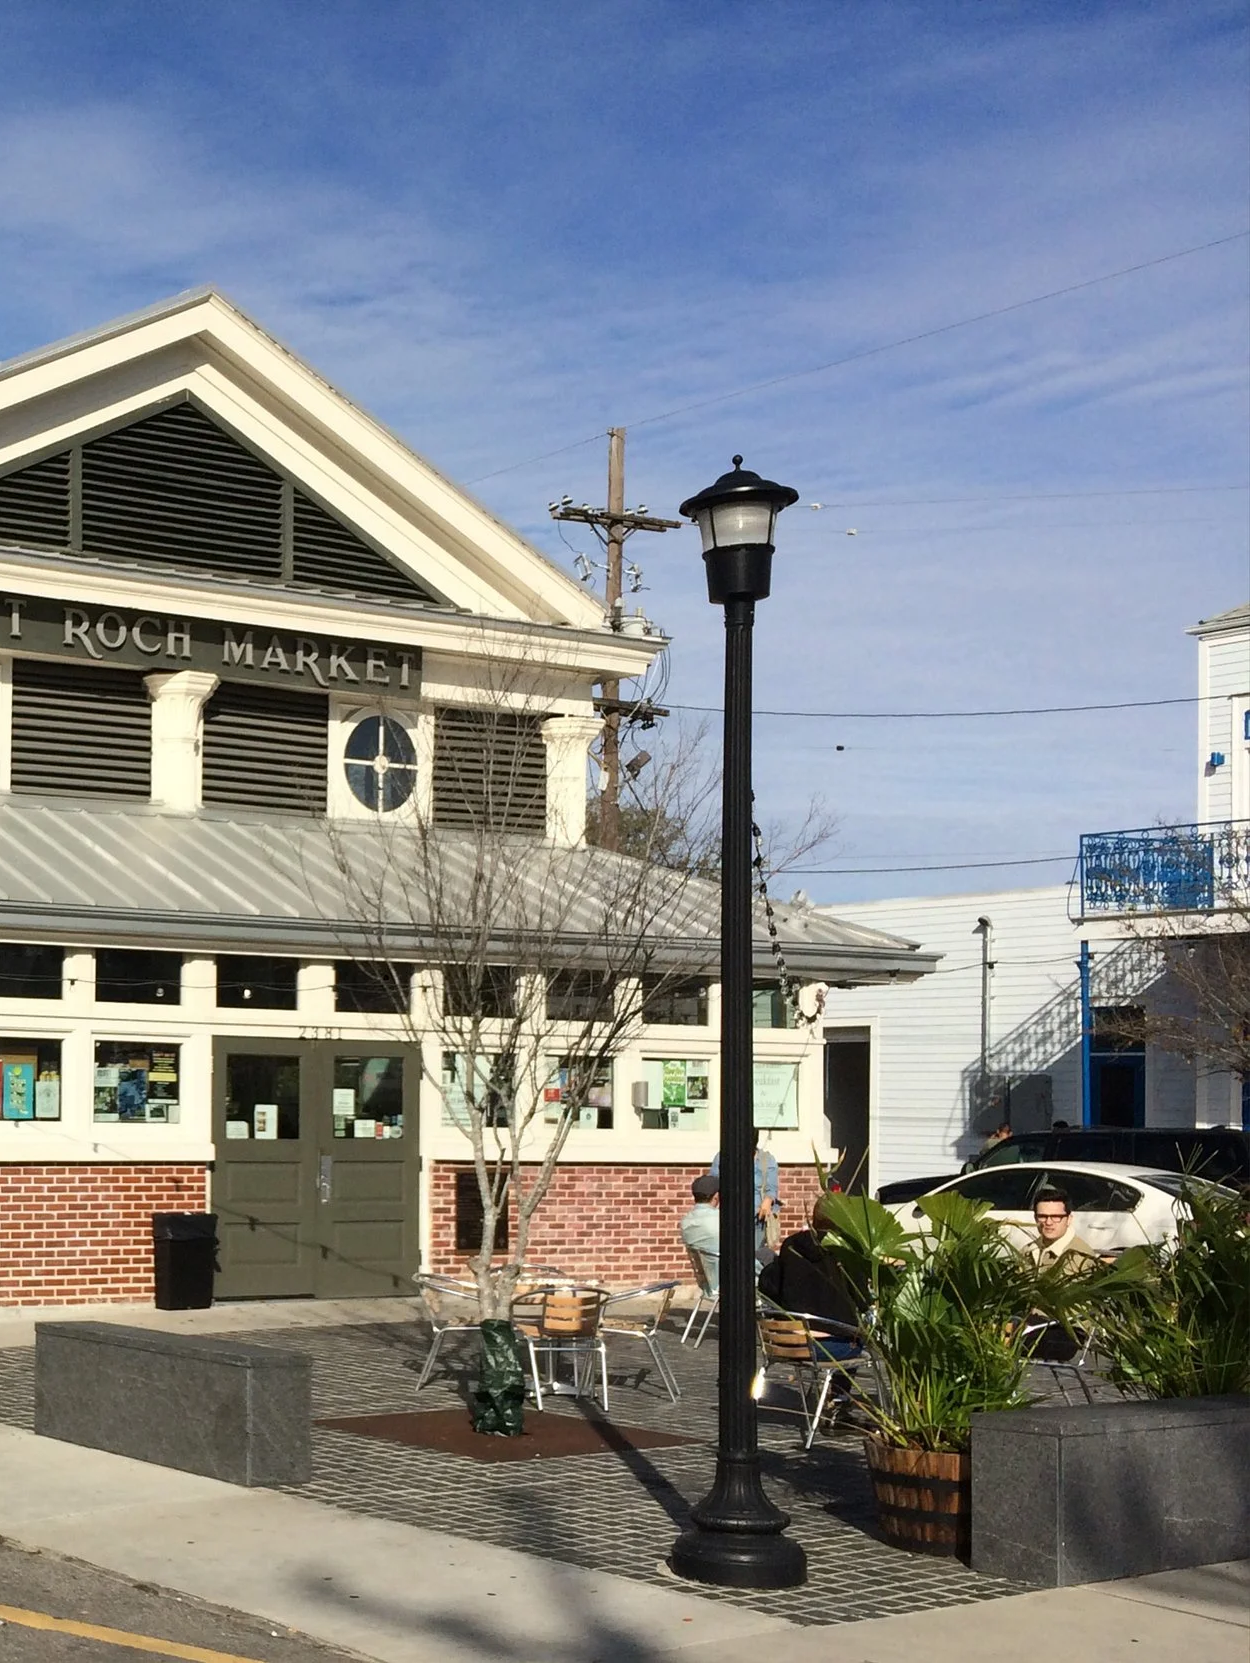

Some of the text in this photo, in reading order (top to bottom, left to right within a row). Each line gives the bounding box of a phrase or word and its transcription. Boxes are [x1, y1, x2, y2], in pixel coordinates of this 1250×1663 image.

[62, 607, 192, 660] ROCH
[221, 627, 416, 689] MARKET
[298, 1025, 342, 1040] 2381
